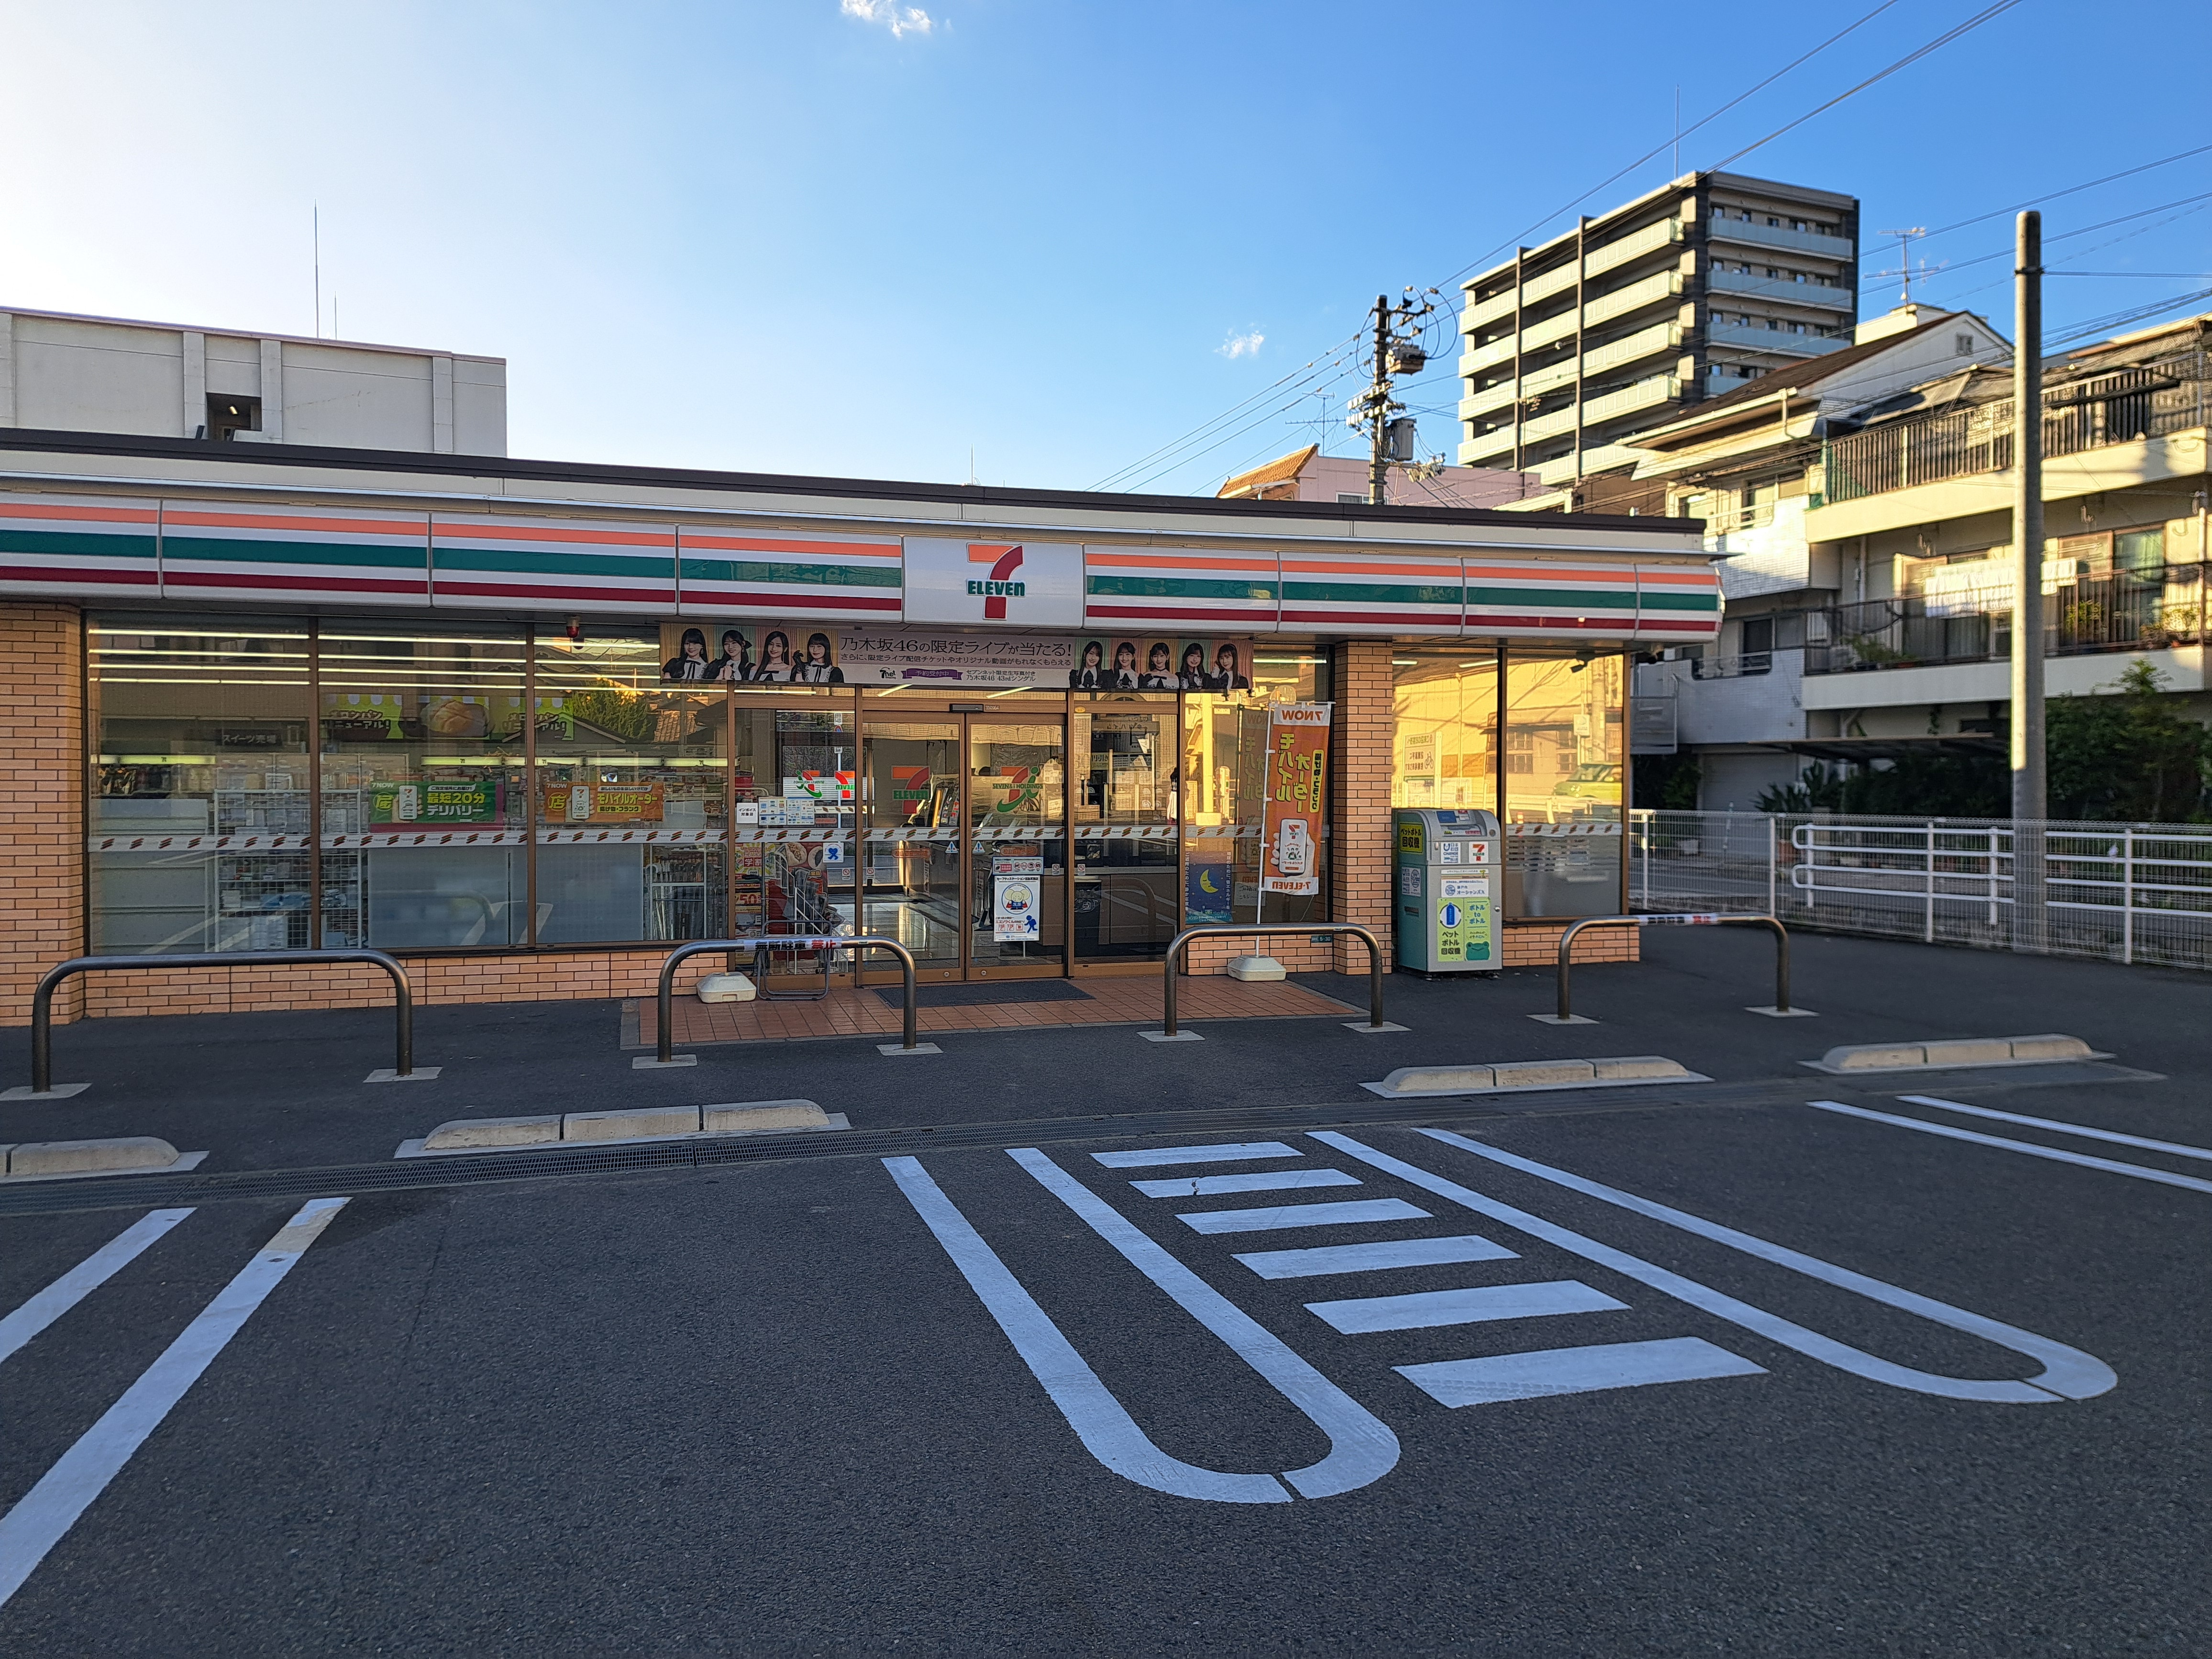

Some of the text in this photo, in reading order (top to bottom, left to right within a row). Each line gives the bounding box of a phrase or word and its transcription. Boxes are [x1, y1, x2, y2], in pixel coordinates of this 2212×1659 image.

[841, 637, 1072, 657] 乃木坂46の限定ライブが当たる!
[427, 792, 485, 804] 最短20分
[597, 793, 658, 804] モバイルオーダー
[427, 805, 484, 816] デリバリー
[1401, 828, 1422, 836] ペットボトル
[1402, 836, 1419, 849] 回収機
[811, 939, 836, 950] 禁止
